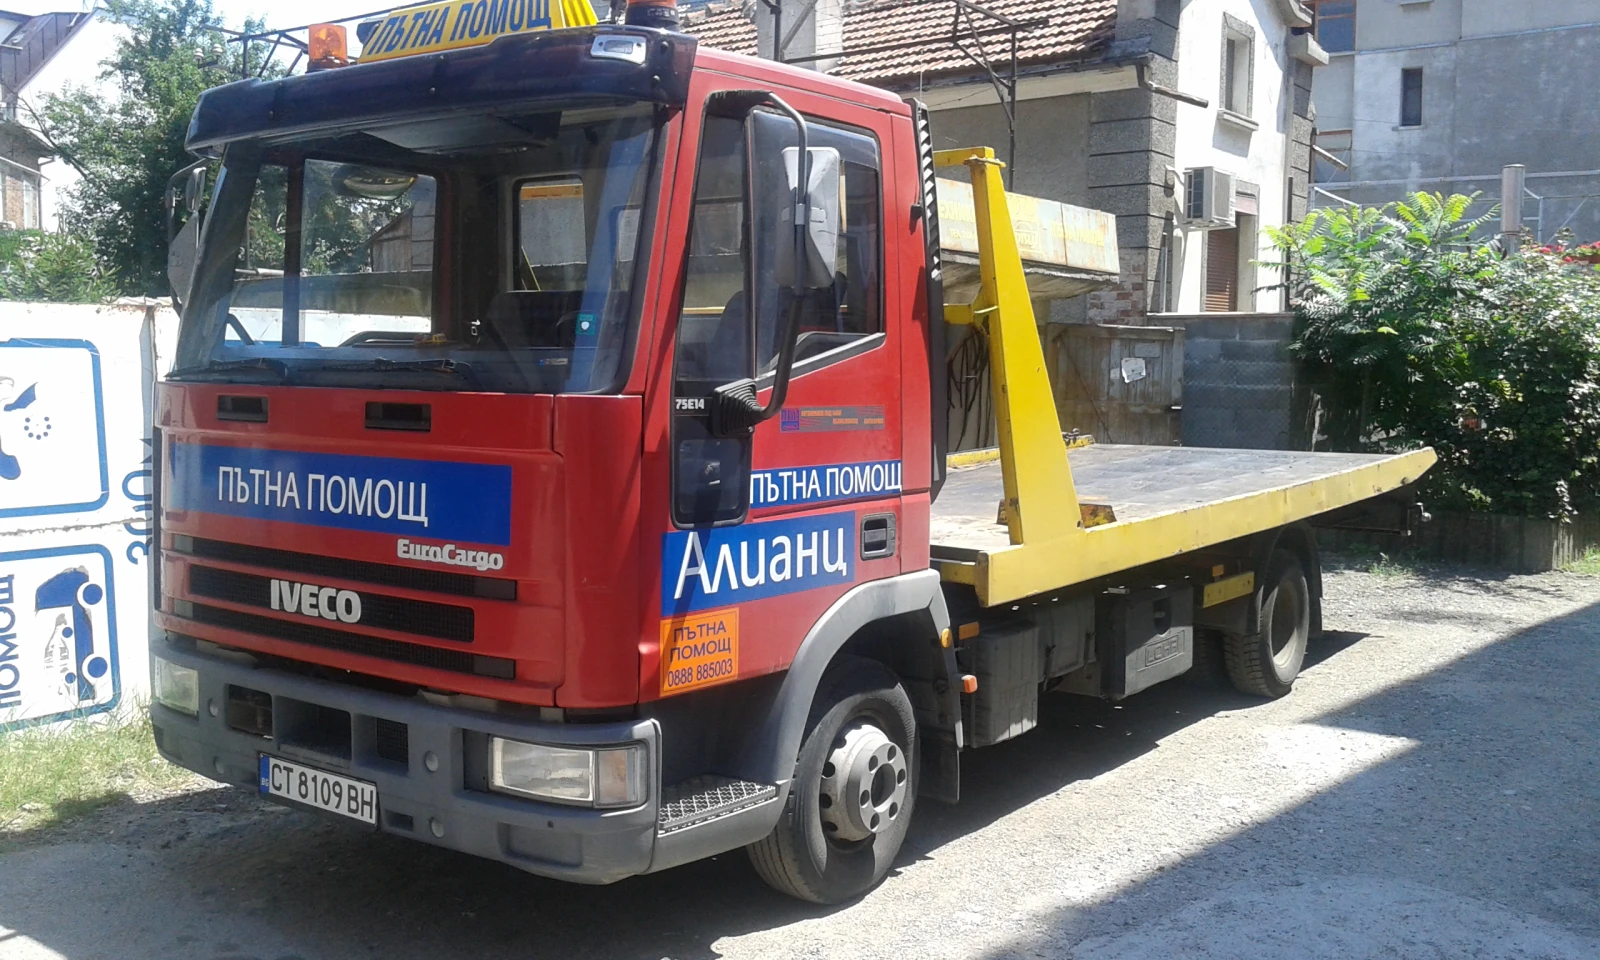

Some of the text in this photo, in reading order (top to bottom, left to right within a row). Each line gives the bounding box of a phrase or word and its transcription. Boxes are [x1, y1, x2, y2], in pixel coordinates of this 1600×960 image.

[367, 0, 552, 56] ПЪТНА ПОМОЩ
[675, 398, 705, 410] 75E14
[218, 466, 429, 528] ПЪТНА ПОМОЩ
[750, 462, 903, 504] ПЪТНА ПОМОЩ
[396, 538, 504, 571] EuroCargo
[673, 526, 848, 600] Алианц
[270, 578, 362, 623] IVECO
[669, 637, 732, 663] ПОМОЩ
[672, 620, 727, 643] ПЪТНА
[667, 657, 733, 688] 0888 885003
[298, 771, 343, 809] 8109
